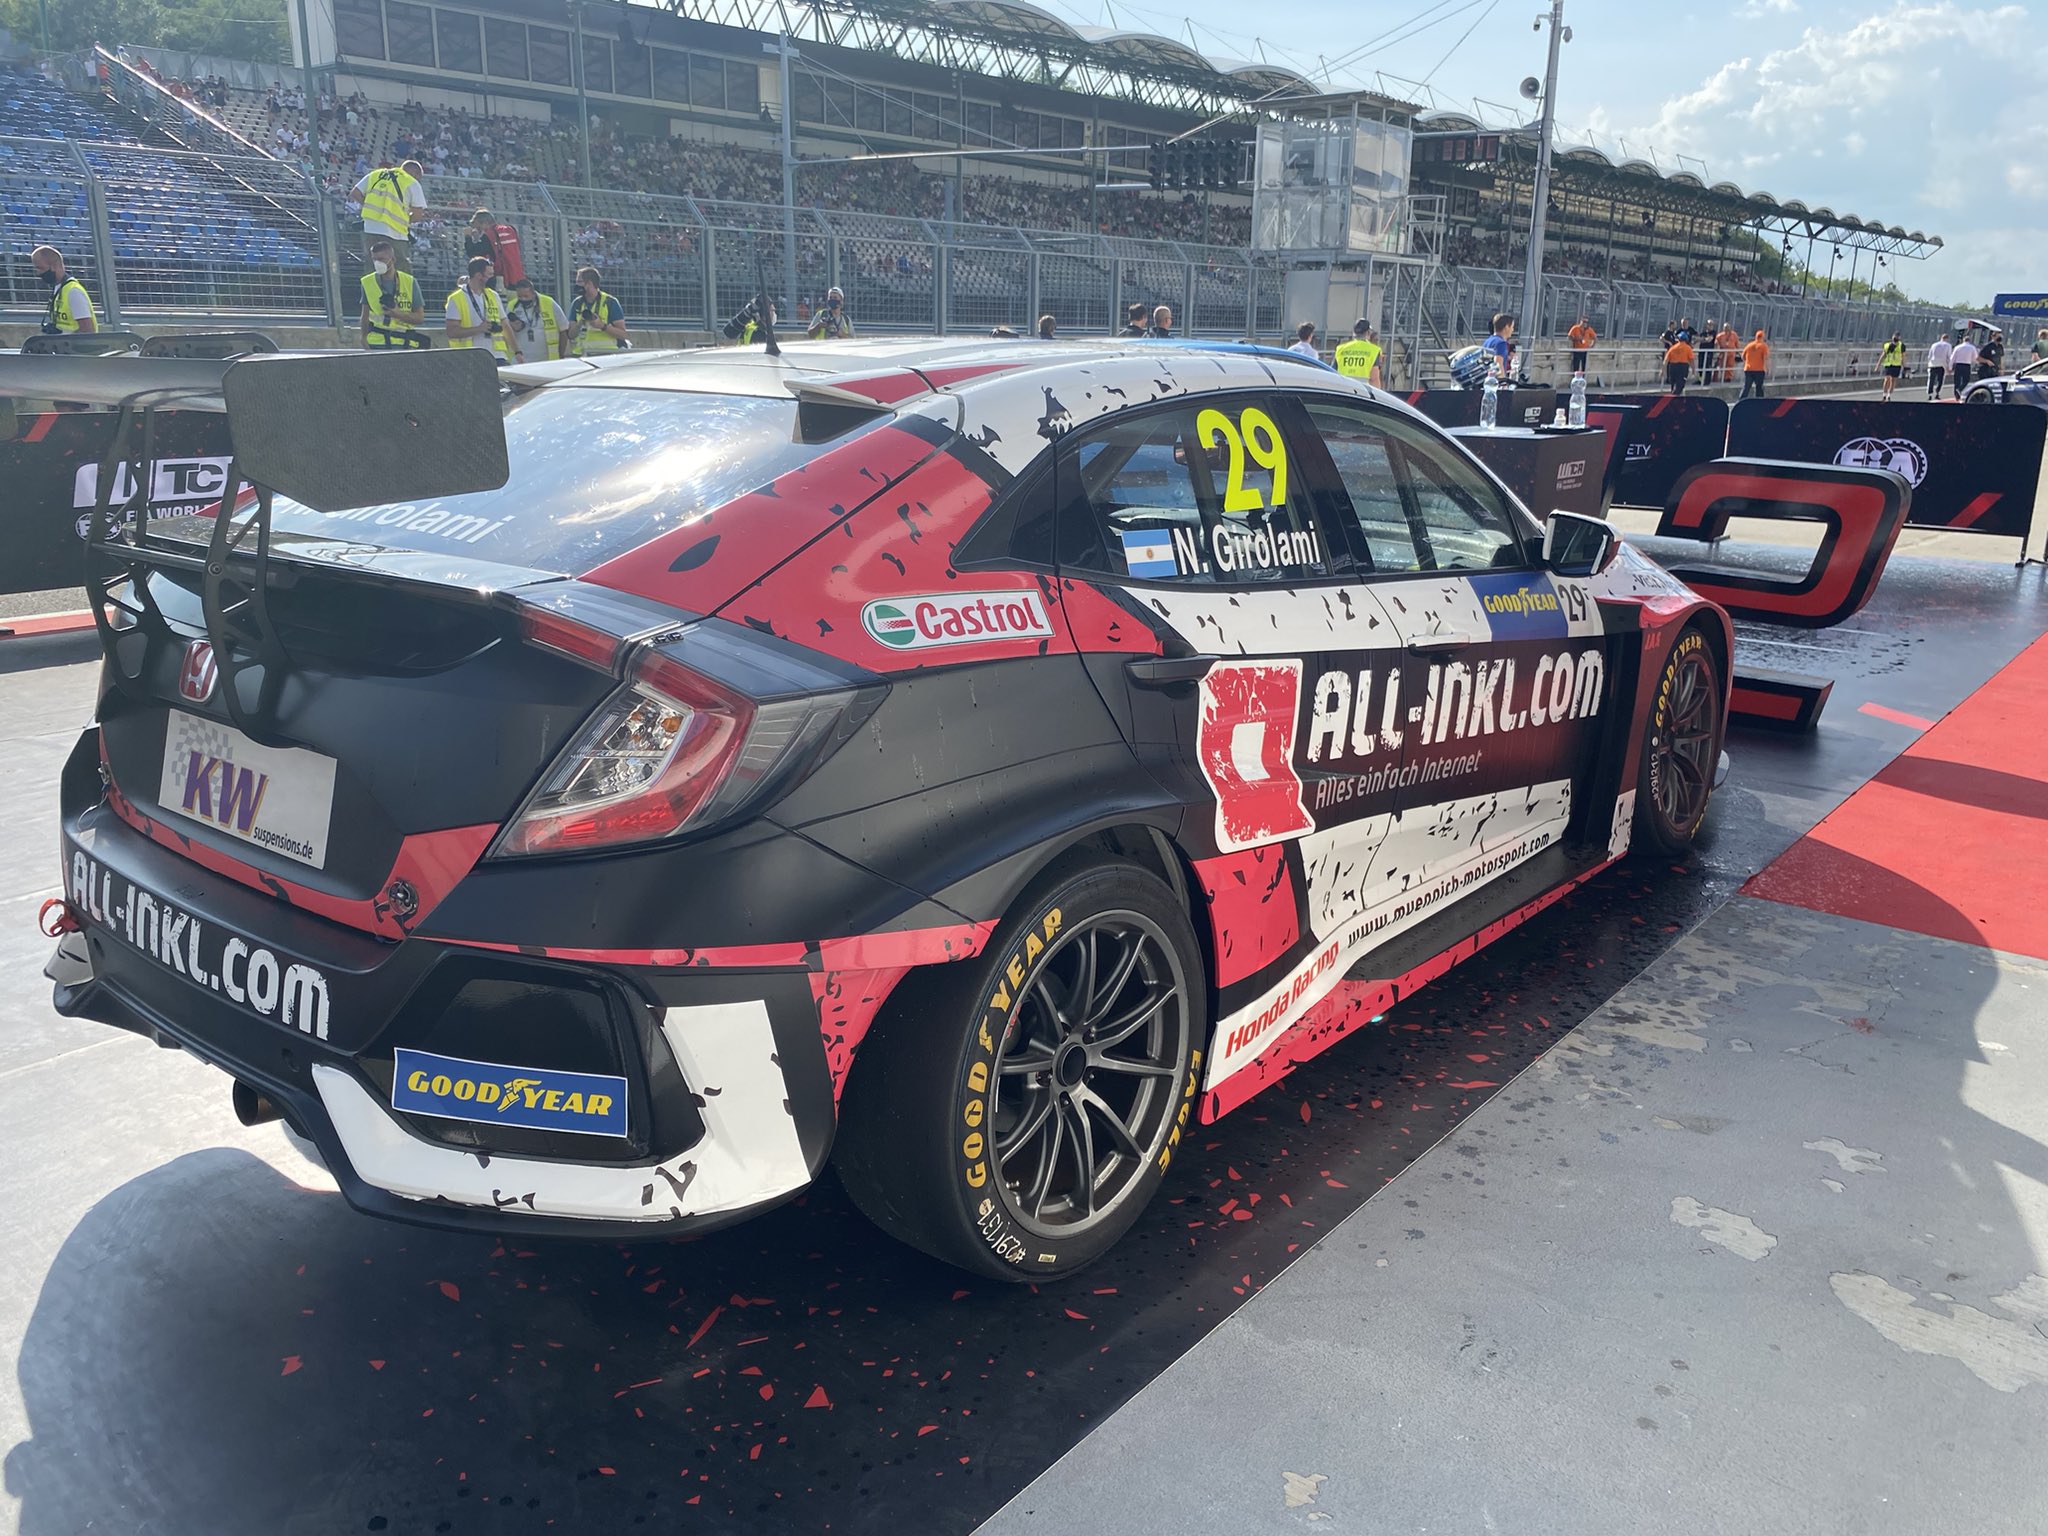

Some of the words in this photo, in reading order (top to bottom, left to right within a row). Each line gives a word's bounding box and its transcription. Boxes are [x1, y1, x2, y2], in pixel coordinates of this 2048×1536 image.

[1343, 357, 1365, 367] FOTO
[1196, 407, 1288, 513] 29
[156, 504, 212, 520] WORL
[1175, 526, 1210, 576] N.
[1212, 520, 1321, 573] Girolami
[914, 593, 1044, 640] Castrol
[1557, 583, 1587, 622] 29
[182, 750, 270, 837] KW
[1315, 776, 1355, 810] Alles
[1357, 758, 1420, 798] einfach
[1420, 749, 1483, 783] Internet
[253, 826, 313, 860] suspensions.de
[1347, 831, 1550, 948] www.muennich-motorsport.com
[1225, 992, 1290, 1058] Honda
[1291, 941, 1339, 1004] Racing
[1157, 1049, 1202, 1177] EAGLE
